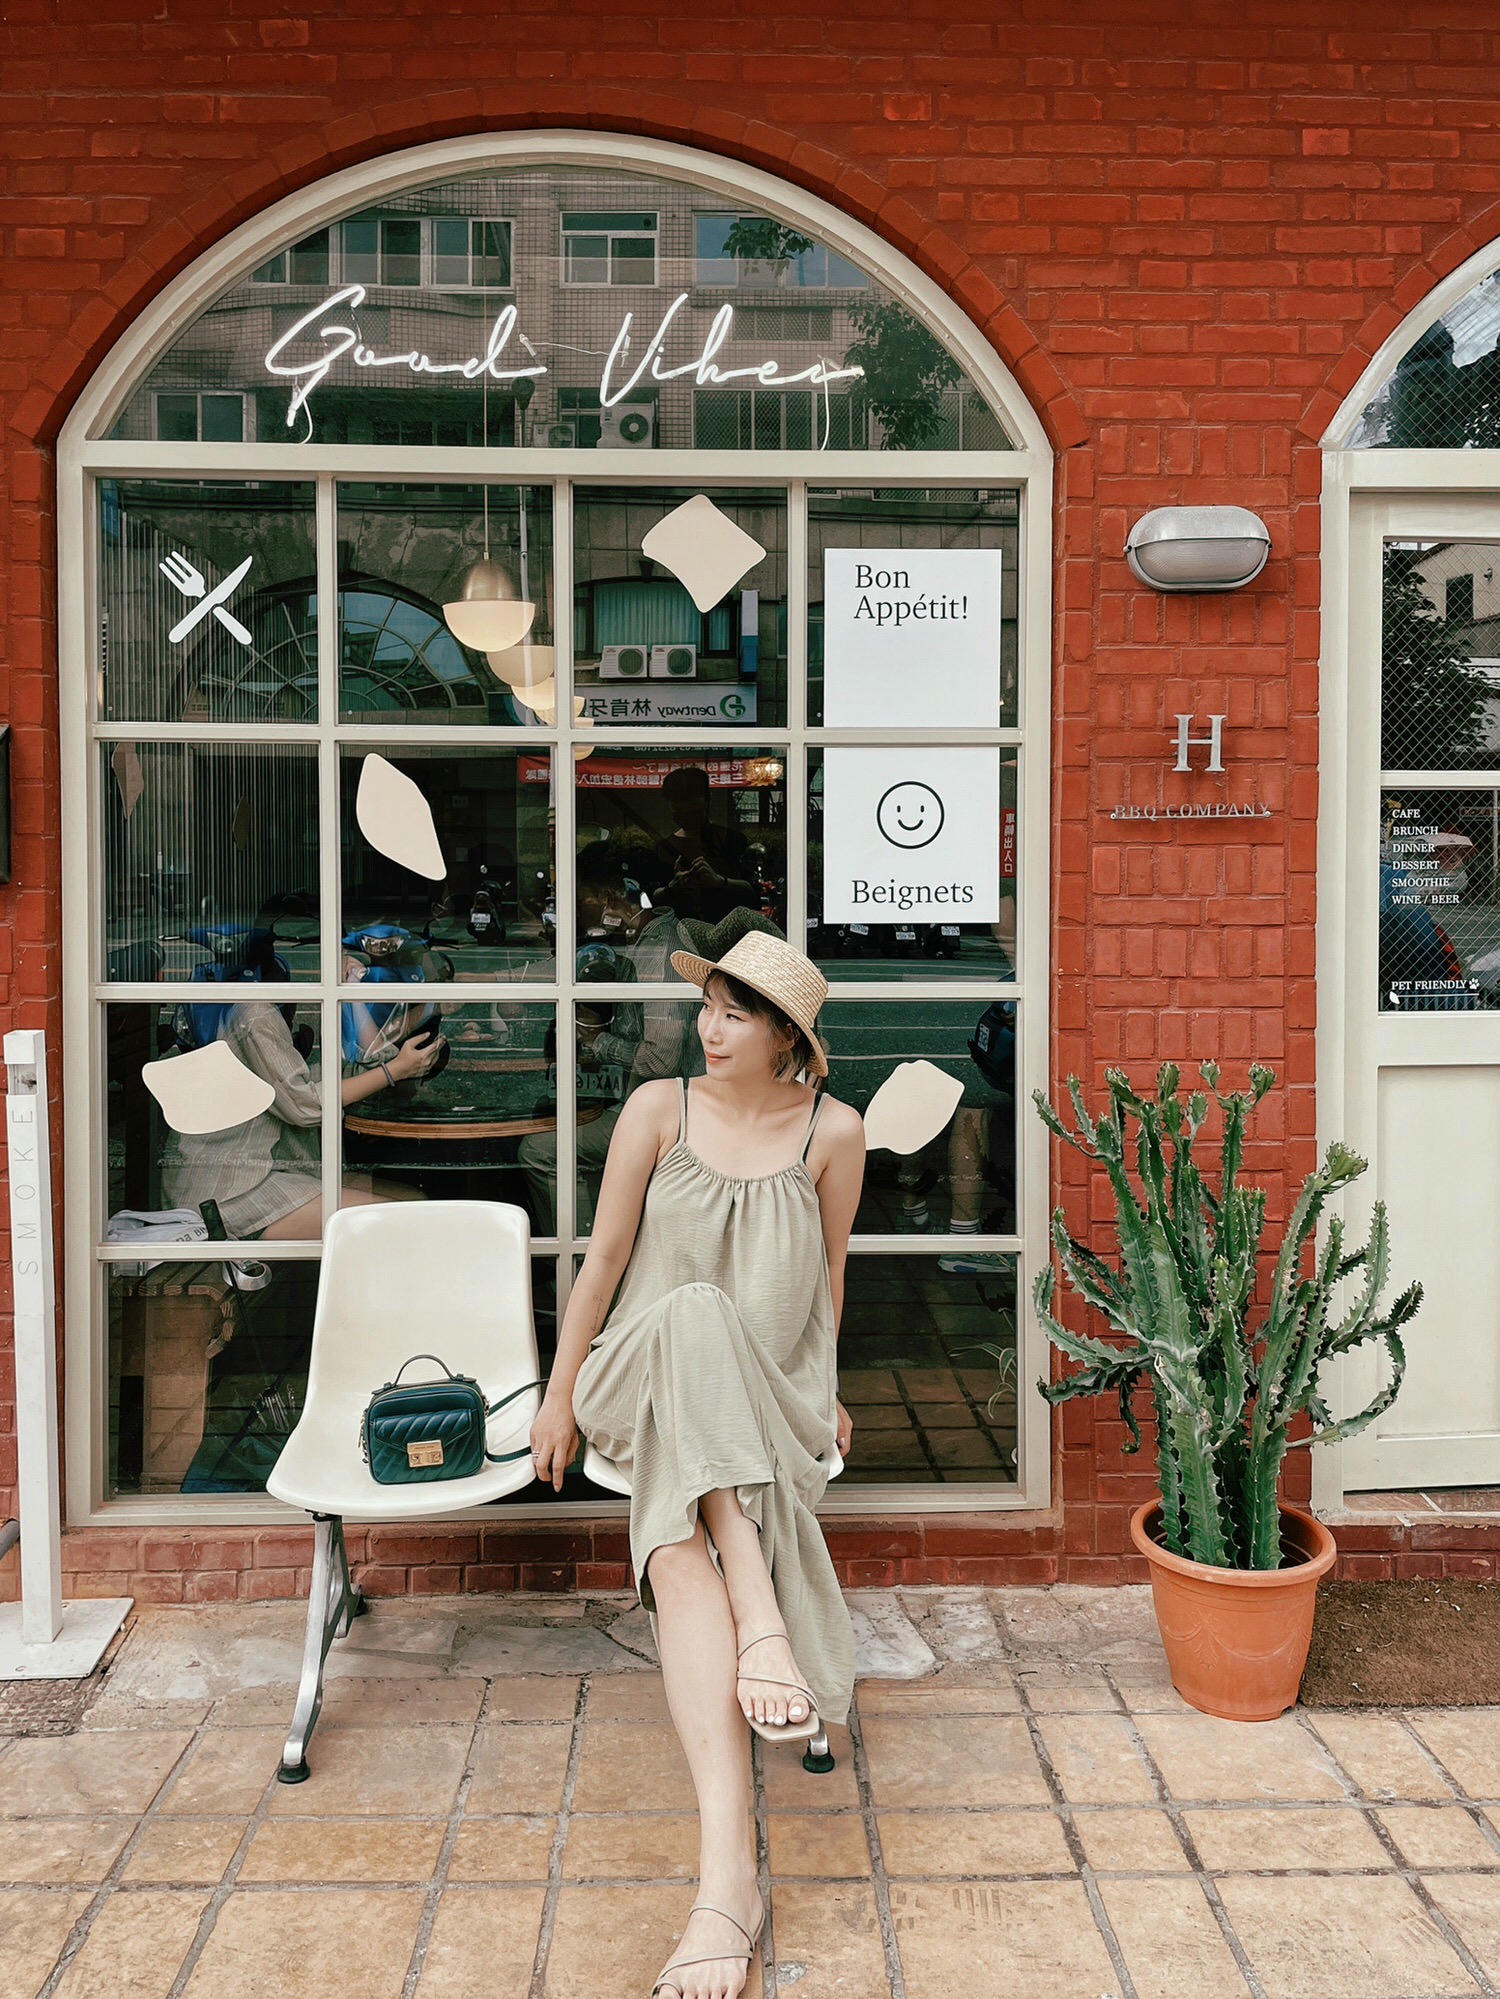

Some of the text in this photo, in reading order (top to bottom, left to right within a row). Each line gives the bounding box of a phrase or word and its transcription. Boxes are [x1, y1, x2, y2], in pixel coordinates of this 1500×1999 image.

[264, 285, 865, 427] Good Vibes
[854, 565, 910, 589] Bon
[853, 594, 969, 627] Appétit!
[1170, 714, 1227, 772] H
[1114, 802, 1271, 821] BBQ COMPANY
[1392, 809, 1421, 819] CAFE
[1393, 826, 1439, 836] BRUNCH
[1392, 843, 1436, 853] DINNER
[1392, 861, 1440, 870] DESSERT
[1392, 878, 1450, 888] SMOOTHIE
[852, 879, 974, 911] Beignets
[1392, 895, 1422, 905] WINE
[1431, 894, 1460, 904] BEER
[1391, 979, 1468, 991] PET FRIENDLY
[11, 1109, 39, 1276] SMOKE
